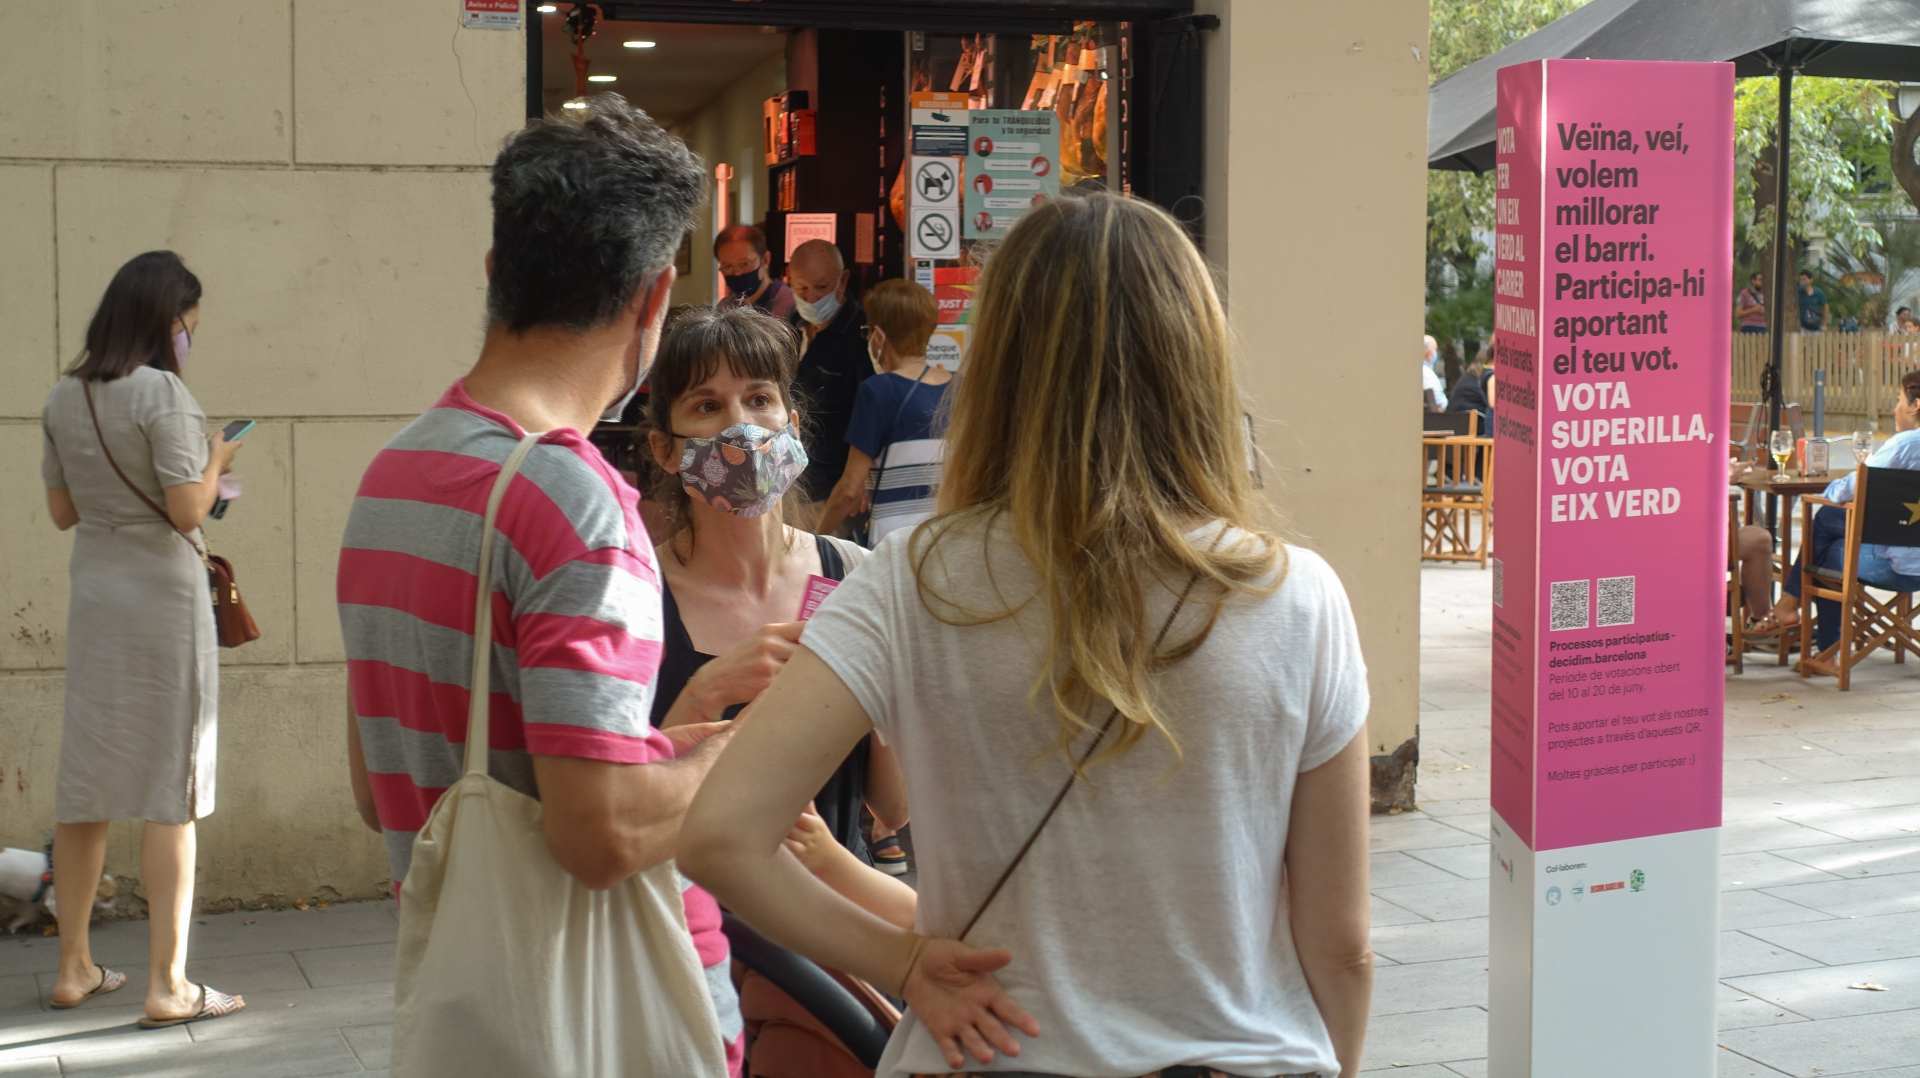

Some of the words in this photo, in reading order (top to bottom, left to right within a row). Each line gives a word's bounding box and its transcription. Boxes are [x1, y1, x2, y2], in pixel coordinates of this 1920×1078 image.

[1557, 122, 1640, 154] Veïna,
[1645, 122, 1689, 154] veí,
[1556, 160, 1638, 188] volem
[1556, 196, 1660, 226] millorar
[1555, 234, 1580, 263] el
[1584, 234, 1655, 262] barri.
[1555, 268, 1705, 304] Participa-hi
[938, 300, 962, 310] JUST
[1554, 310, 1668, 344] aportant
[1554, 346, 1577, 374] el
[1582, 349, 1625, 374] teu
[1630, 347, 1678, 370] vot.
[1552, 382, 1631, 412] VOTA
[1552, 414, 1714, 449] SUPERILLA,
[1551, 454, 1630, 486] VOTA
[1551, 492, 1599, 522] EIX
[1604, 487, 1681, 518] VERD
[1549, 650, 1647, 668] decidim.barcelona
[1550, 639, 1604, 652] Processos
[1590, 670, 1602, 680] de
[1549, 688, 1564, 700] del
[1568, 688, 1579, 699] 10
[1581, 687, 1590, 697] al
[1592, 685, 1606, 697] 20
[1608, 684, 1621, 694] de
[1572, 718, 1608, 732] aportar
[1622, 714, 1638, 725] teu
[1640, 712, 1656, 724] vot
[1674, 706, 1709, 718] nostres
[1548, 770, 1581, 781] Moltes
